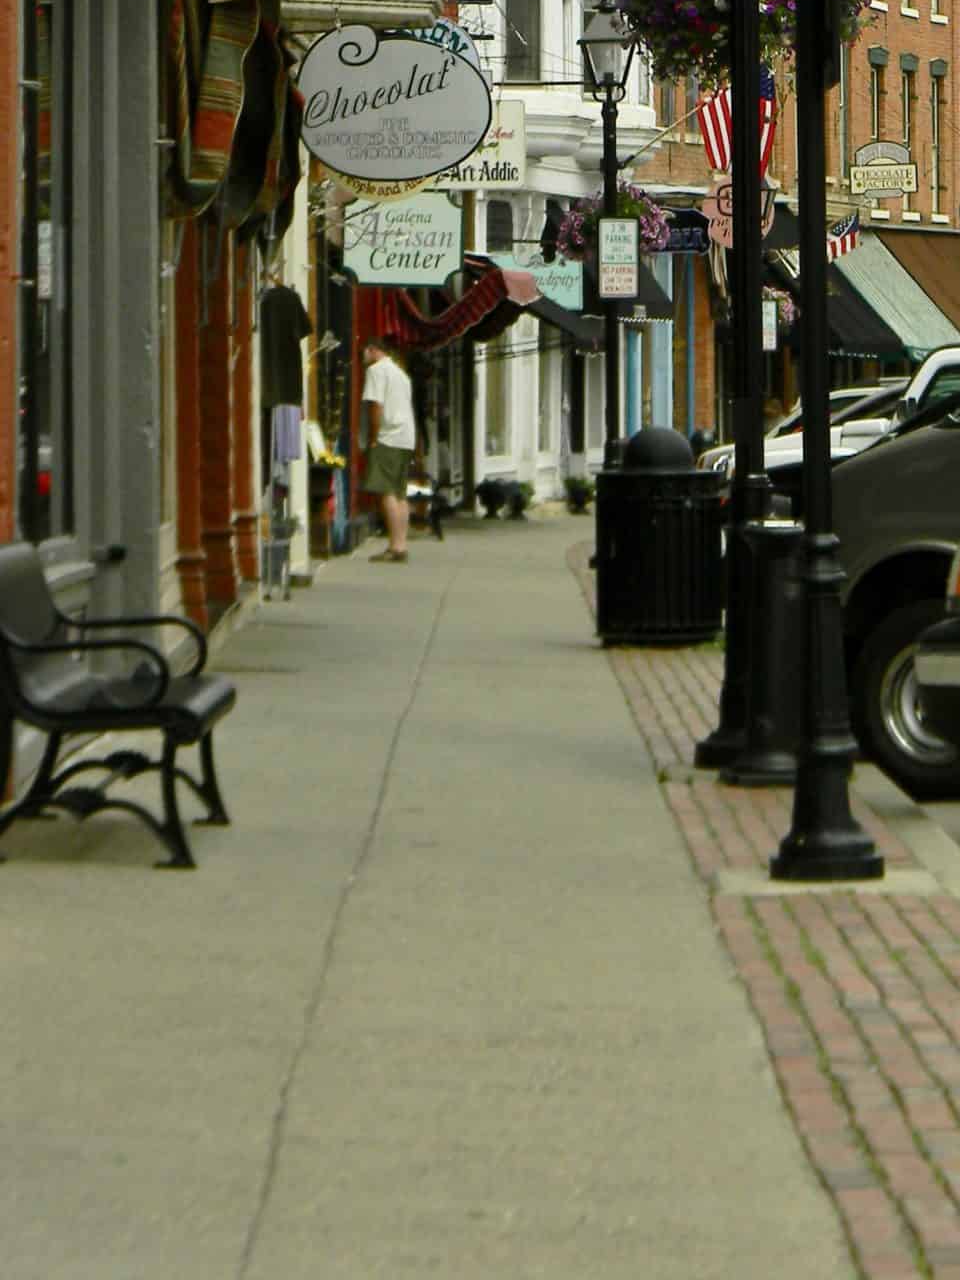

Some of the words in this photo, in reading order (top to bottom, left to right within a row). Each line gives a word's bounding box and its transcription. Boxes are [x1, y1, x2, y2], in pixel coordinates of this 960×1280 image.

[853, 167, 913, 180] CHOCOLATE
[863, 179, 905, 189] FACTORY
[384, 209, 432, 226] Galena
[345, 212, 454, 250] Artisan
[369, 246, 446, 269] Center
